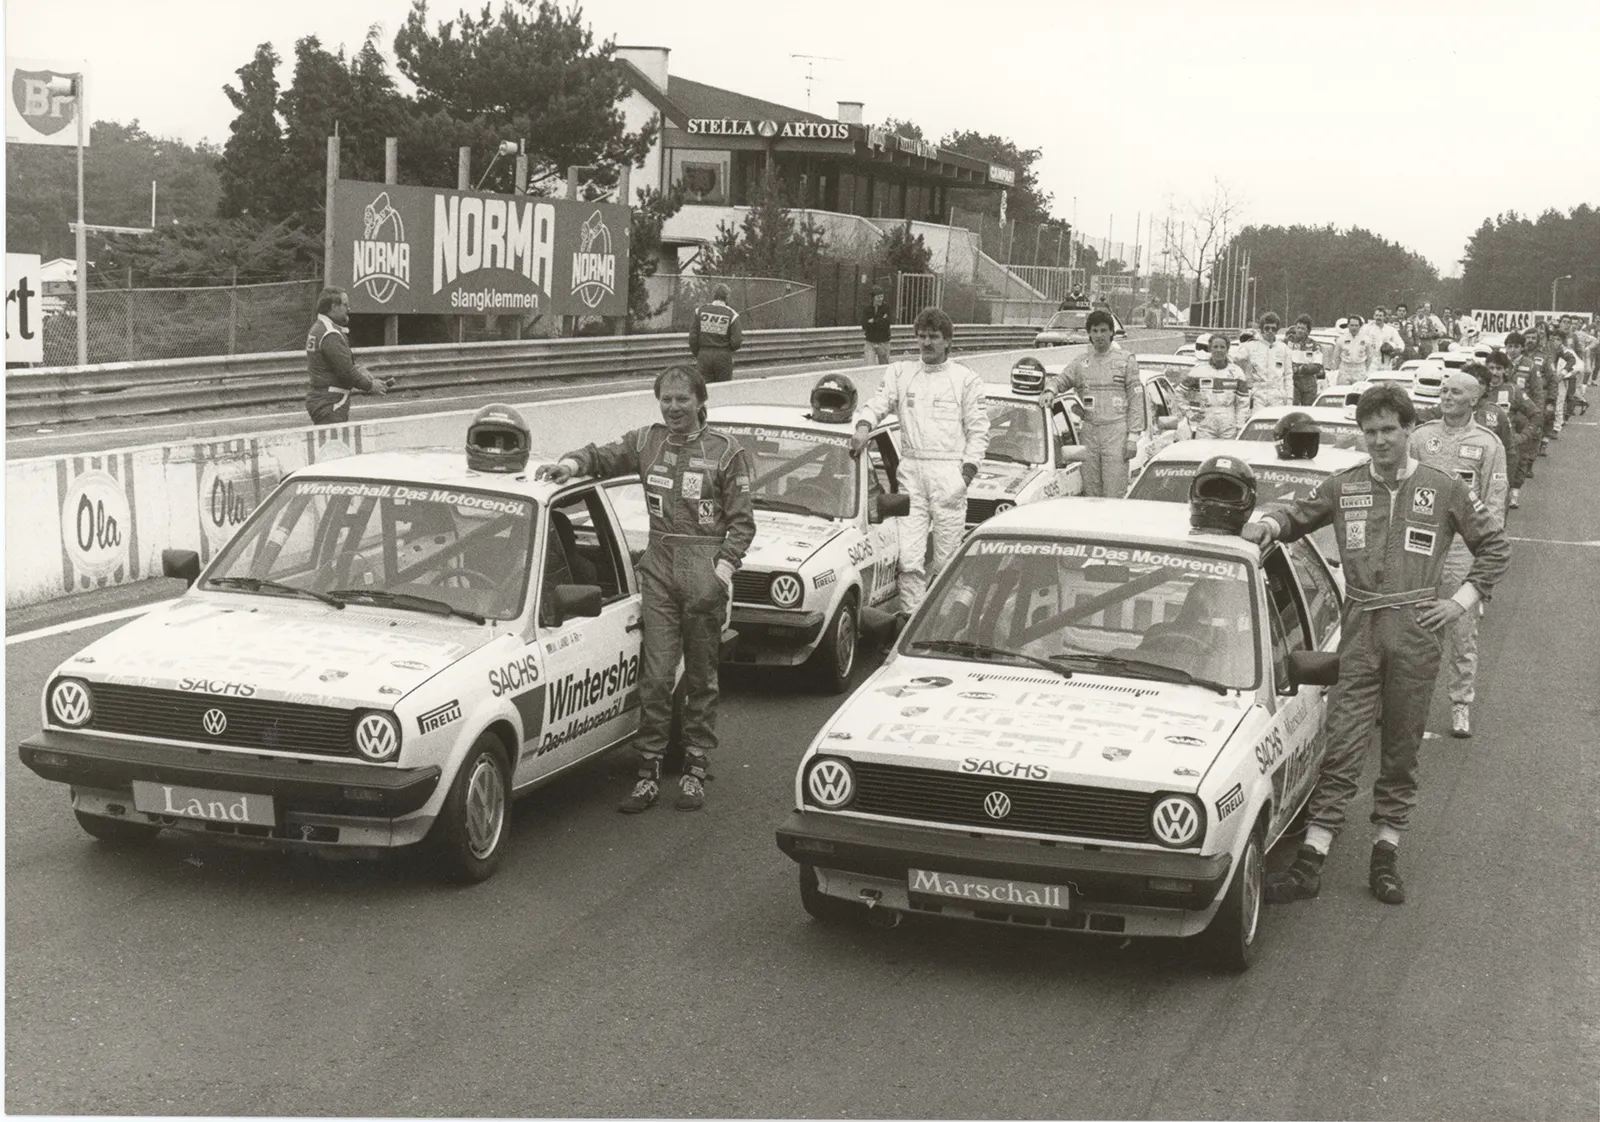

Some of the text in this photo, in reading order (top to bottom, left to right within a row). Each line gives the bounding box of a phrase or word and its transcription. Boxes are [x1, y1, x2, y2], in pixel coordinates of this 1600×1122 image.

[687, 118, 849, 139] STELLA ARTOIS
[353, 240, 410, 286] NORMA
[433, 194, 555, 298] NORMA
[571, 252, 616, 290] NORMA
[451, 287, 538, 311] slangklemmen
[700, 314, 729, 325] ONS
[754, 427, 779, 437] Das
[781, 429, 849, 448] Motorenöl.
[1155, 468, 1196, 477] Winter
[1263, 471, 1323, 487] Motoren
[211, 474, 248, 528] Ola
[296, 484, 525, 517] Wintershall. Das Motorenöl.
[77, 492, 121, 552] Ola
[980, 542, 1237, 578] Wintershall. Das Motorenöl.
[812, 568, 836, 590] PIRELLI
[178, 677, 257, 697] SACHS
[488, 654, 539, 697] SACHS
[549, 651, 639, 725] Wintersha
[416, 699, 462, 735] PIRELLI
[962, 757, 1049, 780] SACHS
[1255, 726, 1283, 775] SACHS
[162, 786, 250, 822] Land
[1215, 782, 1245, 821] PIRELLI
[913, 870, 1061, 907] Marschall
